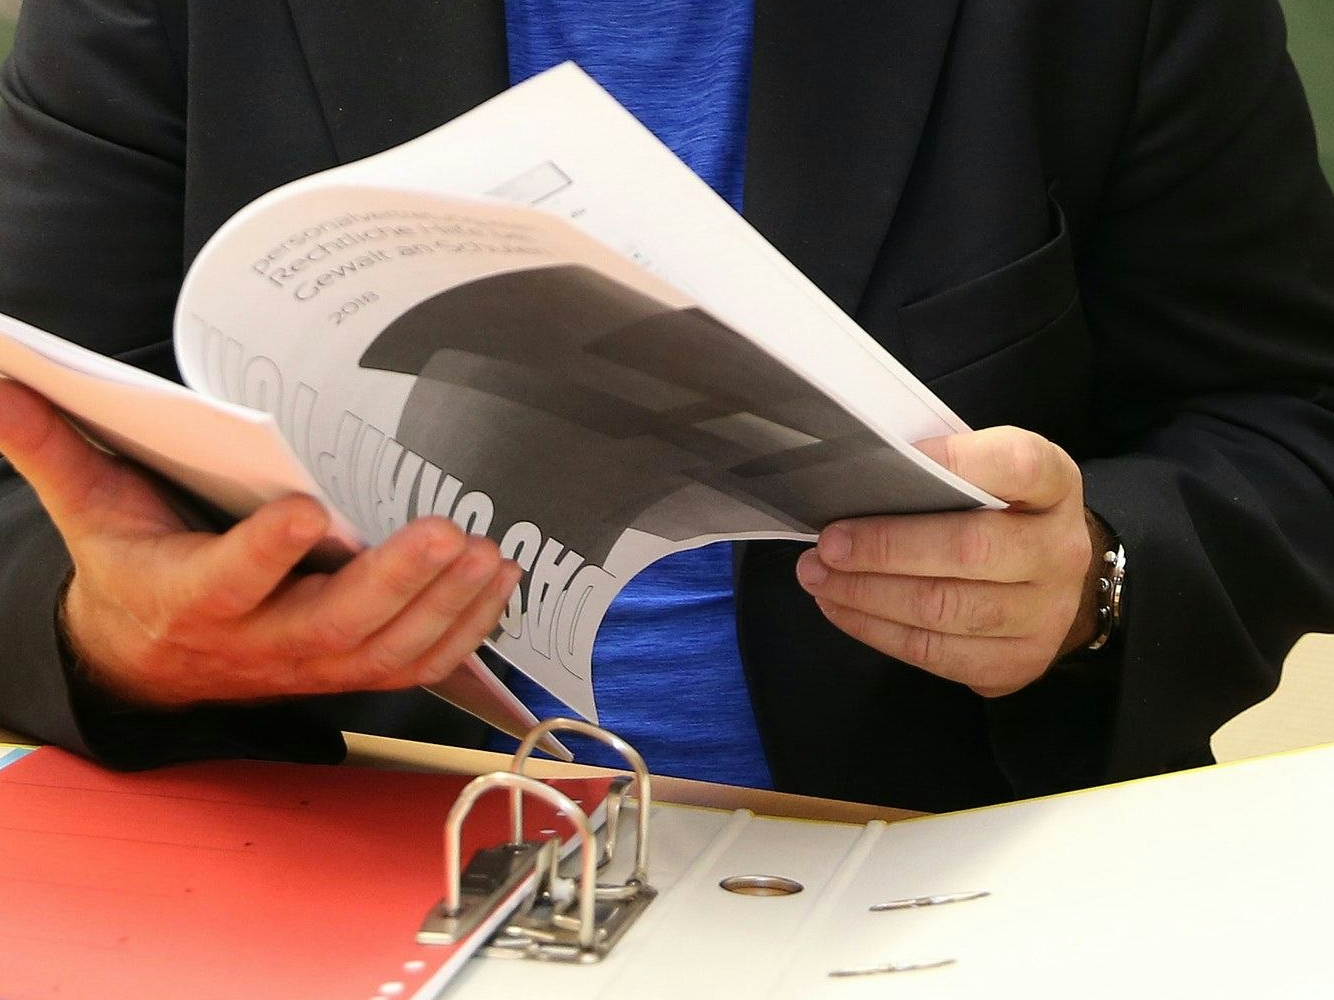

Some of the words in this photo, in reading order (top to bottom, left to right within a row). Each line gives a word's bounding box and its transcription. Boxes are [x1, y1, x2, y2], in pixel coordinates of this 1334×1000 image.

[269, 226, 413, 287] Rechtliche
[293, 248, 393, 301] Gewalt
[395, 243, 435, 257] an
[328, 290, 380, 325] 2018
[499, 520, 617, 682] DAS
